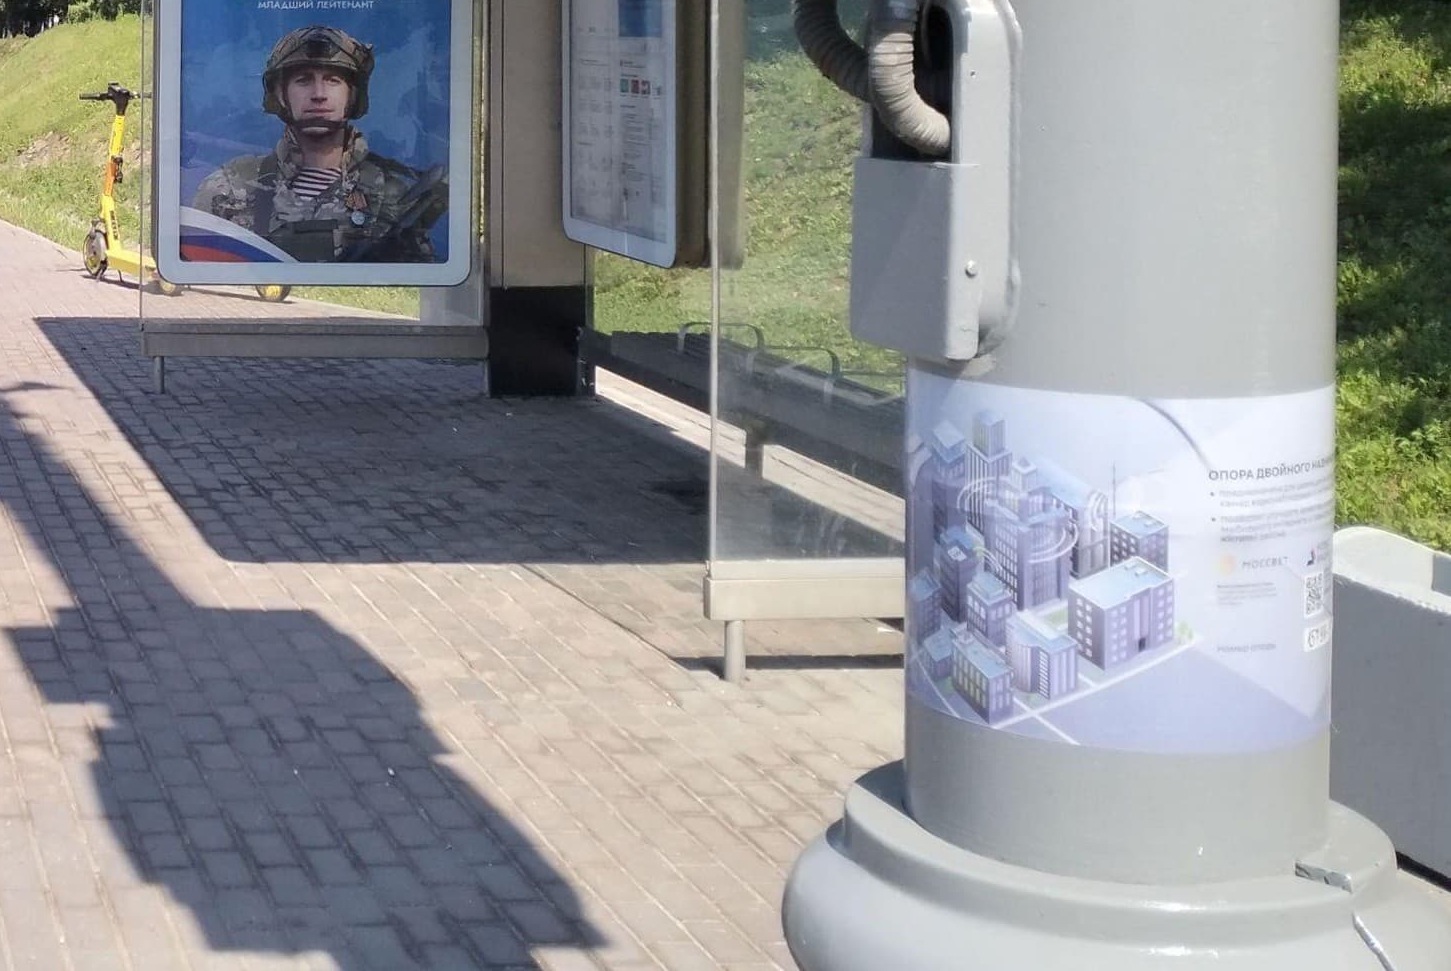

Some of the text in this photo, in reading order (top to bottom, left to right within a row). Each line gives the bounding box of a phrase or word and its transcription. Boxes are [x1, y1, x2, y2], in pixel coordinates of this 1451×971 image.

[257, 0, 374, 10] МЛАДШИЙ ЛЕЙТЕНАНТ
[1208, 469, 1254, 481] ОПОРА
[1256, 462, 1311, 480] ДВОЙНОГО
